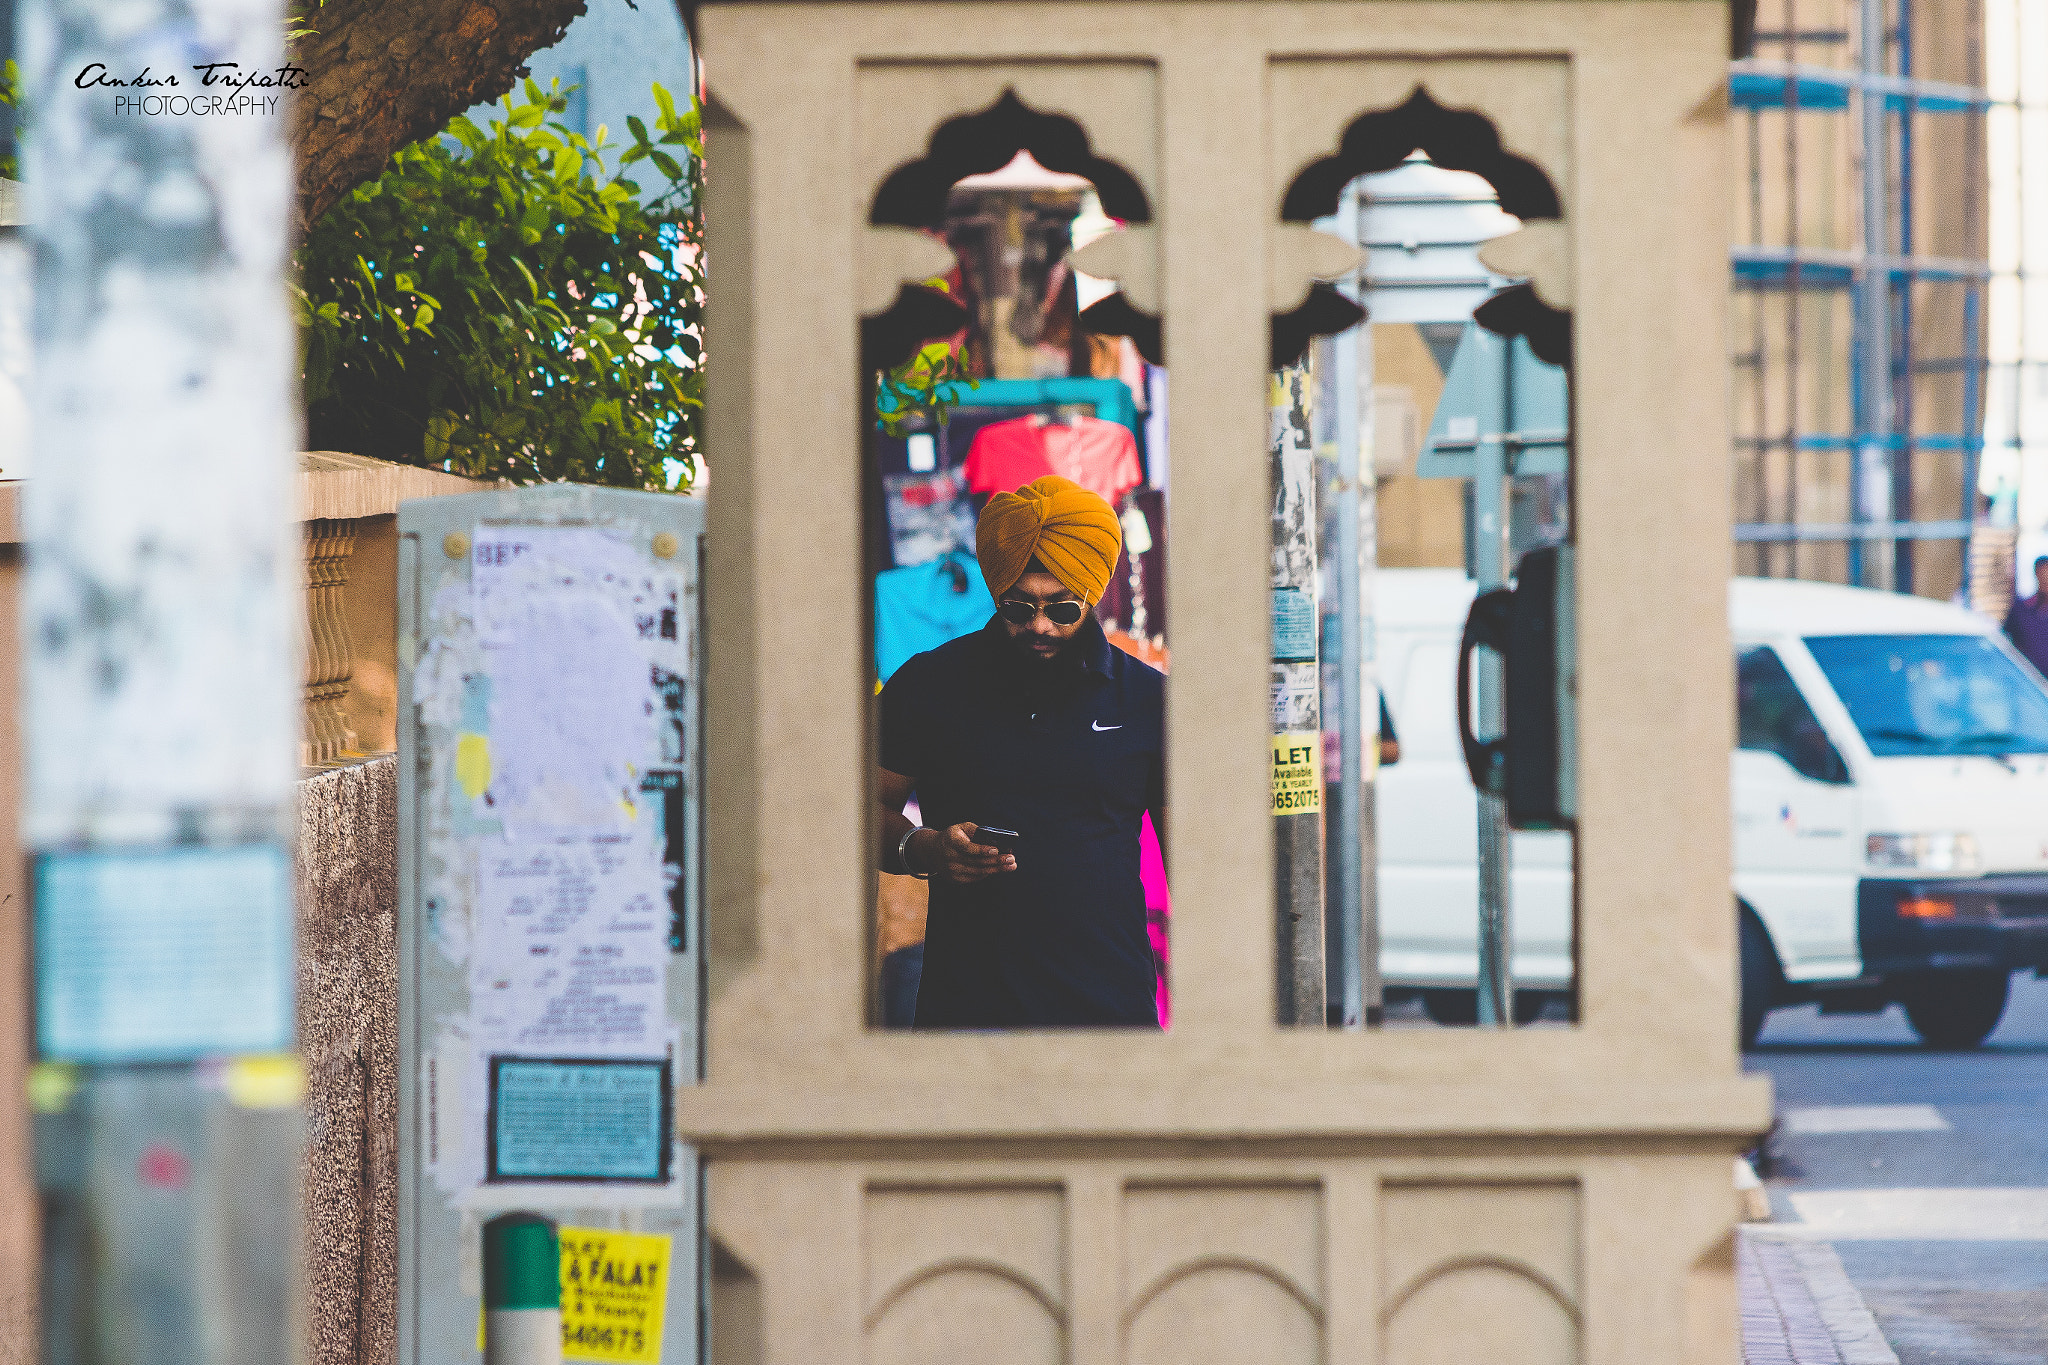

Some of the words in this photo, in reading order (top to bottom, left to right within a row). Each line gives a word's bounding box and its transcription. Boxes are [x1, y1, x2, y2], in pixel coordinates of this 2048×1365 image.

[1274, 747, 1312, 765] LET
[1274, 767, 1313, 779] Available
[1290, 780, 1312, 788] YEARLY
